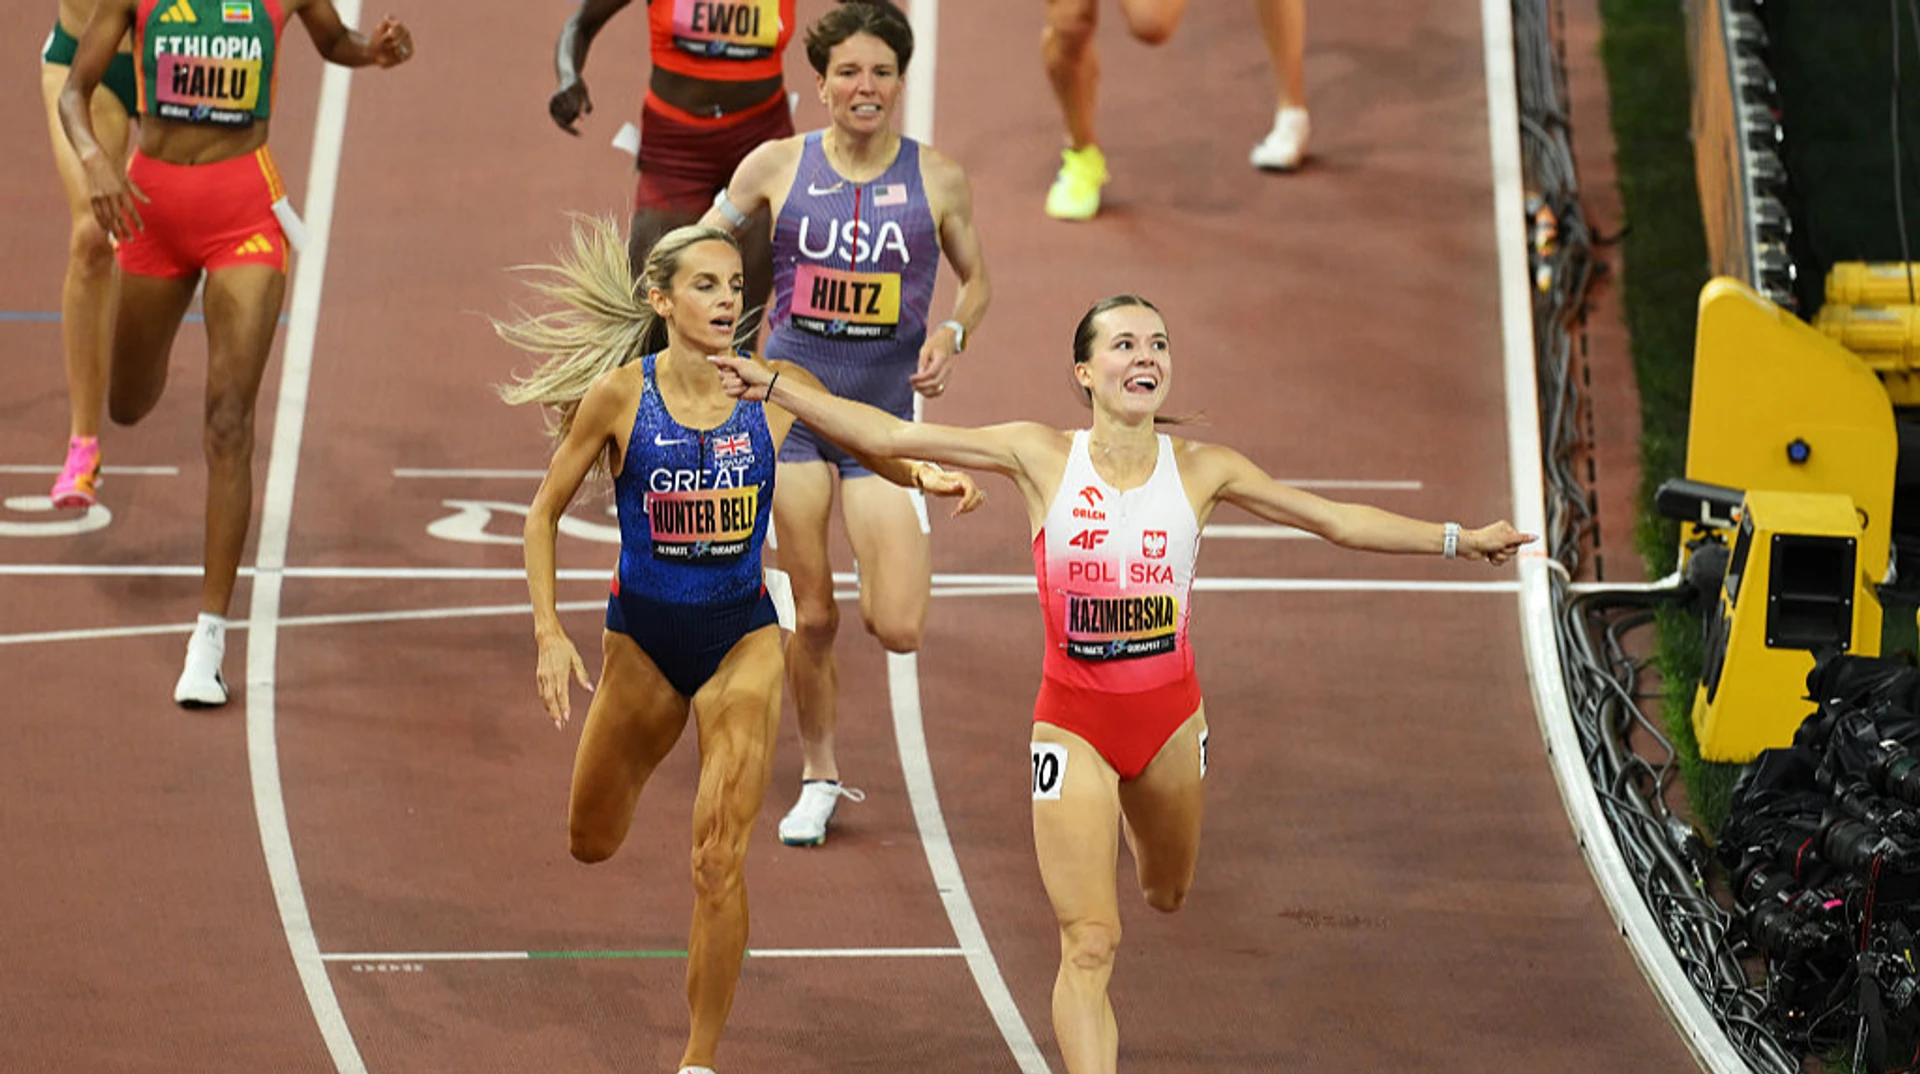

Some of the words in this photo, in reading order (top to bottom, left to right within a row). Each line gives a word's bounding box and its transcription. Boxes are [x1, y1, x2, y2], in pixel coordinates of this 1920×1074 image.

[691, 1, 760, 37] EWOI
[154, 35, 262, 61] ETHIOPIA
[173, 63, 247, 100] HAILU
[799, 216, 911, 264] USA
[811, 276, 882, 315] HILTZ
[650, 464, 749, 494] GREAT
[652, 498, 716, 535] HUNTER
[720, 495, 753, 533] BELL
[1072, 507, 1106, 521] ORLEN
[1069, 596, 1174, 634] KAZIMIERSKA
[1033, 752, 1059, 793] 10
